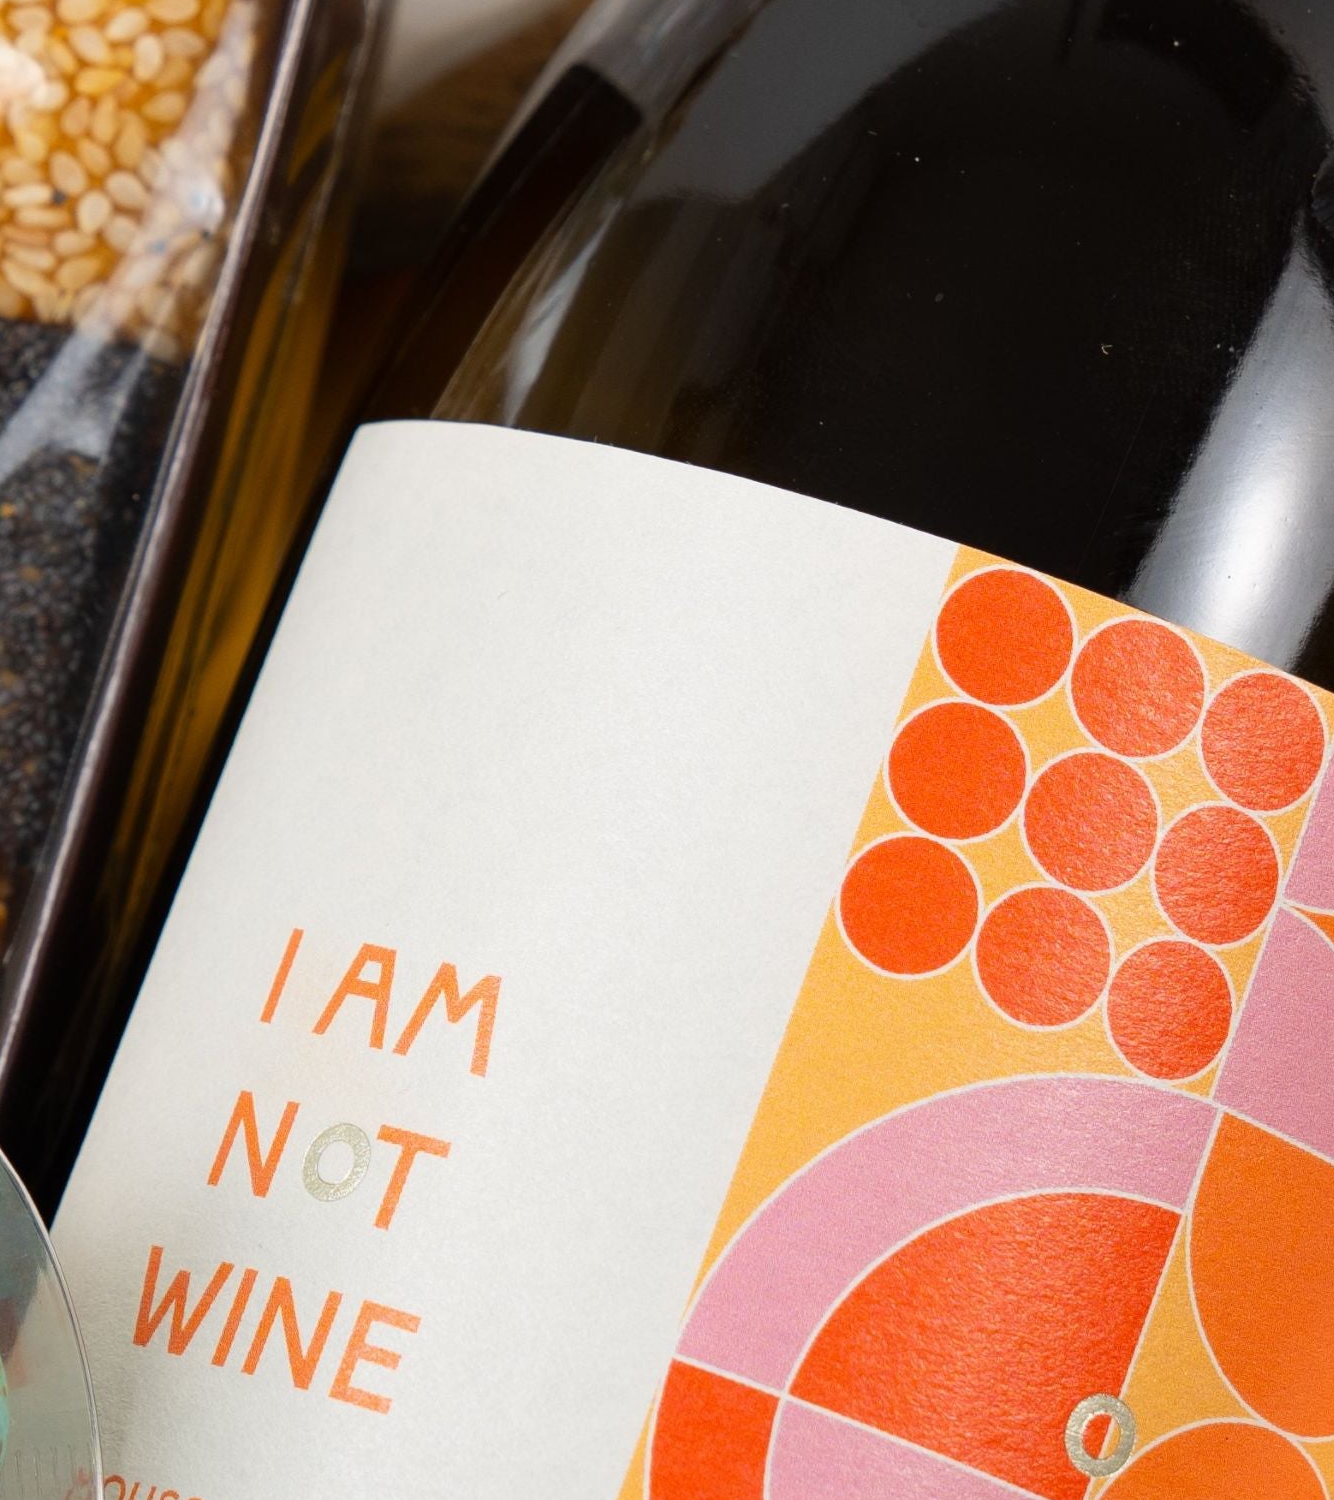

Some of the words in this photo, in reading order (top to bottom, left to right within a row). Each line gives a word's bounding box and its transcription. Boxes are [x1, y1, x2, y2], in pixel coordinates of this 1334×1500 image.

[260, 928, 304, 1024] I
[312, 942, 502, 1078] AM
[207, 1090, 452, 1231] NOT
[131, 1245, 422, 1415] WINE
